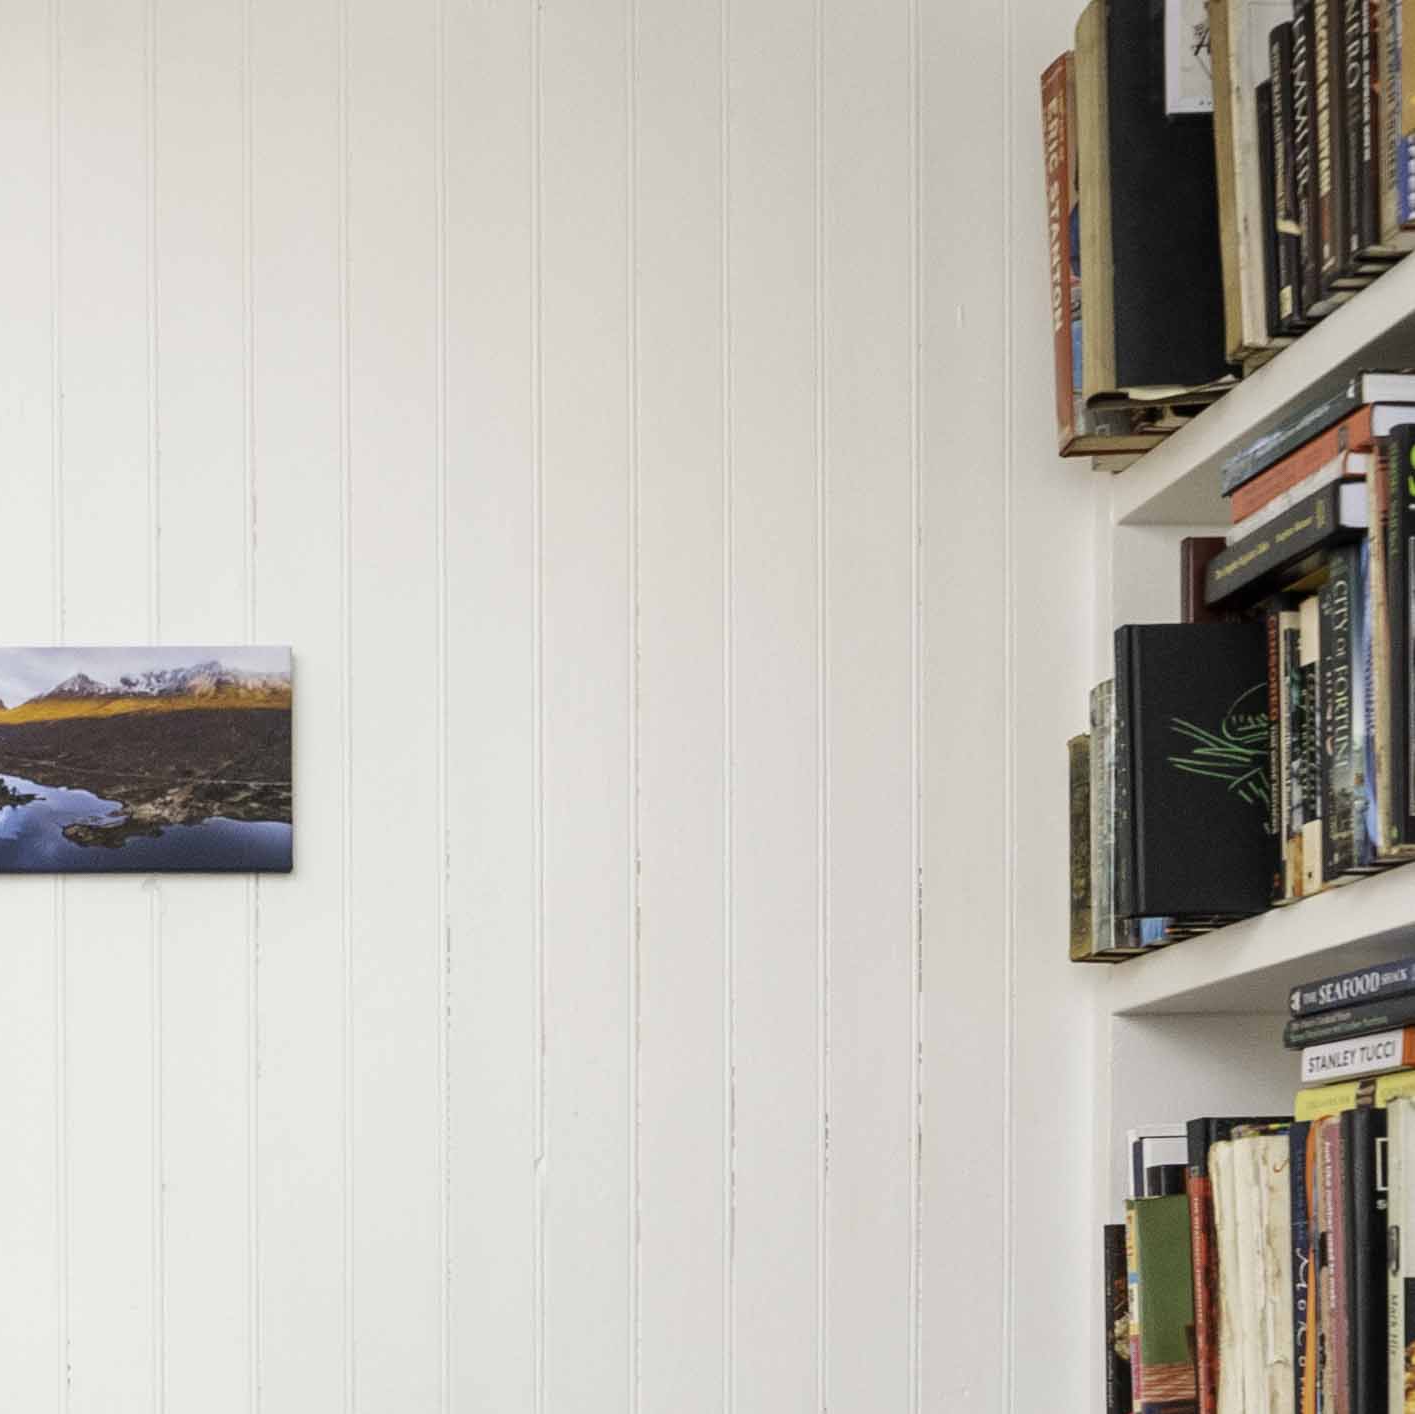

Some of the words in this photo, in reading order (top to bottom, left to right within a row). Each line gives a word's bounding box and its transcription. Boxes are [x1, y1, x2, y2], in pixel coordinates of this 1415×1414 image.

[1048, 180, 1063, 333] STANTON
[1334, 580, 1348, 633] CITY
[1317, 971, 1381, 1005] SEAFOOD
[1307, 1048, 1356, 1073] STANLEY
[1359, 1040, 1394, 1063] TUCCI
